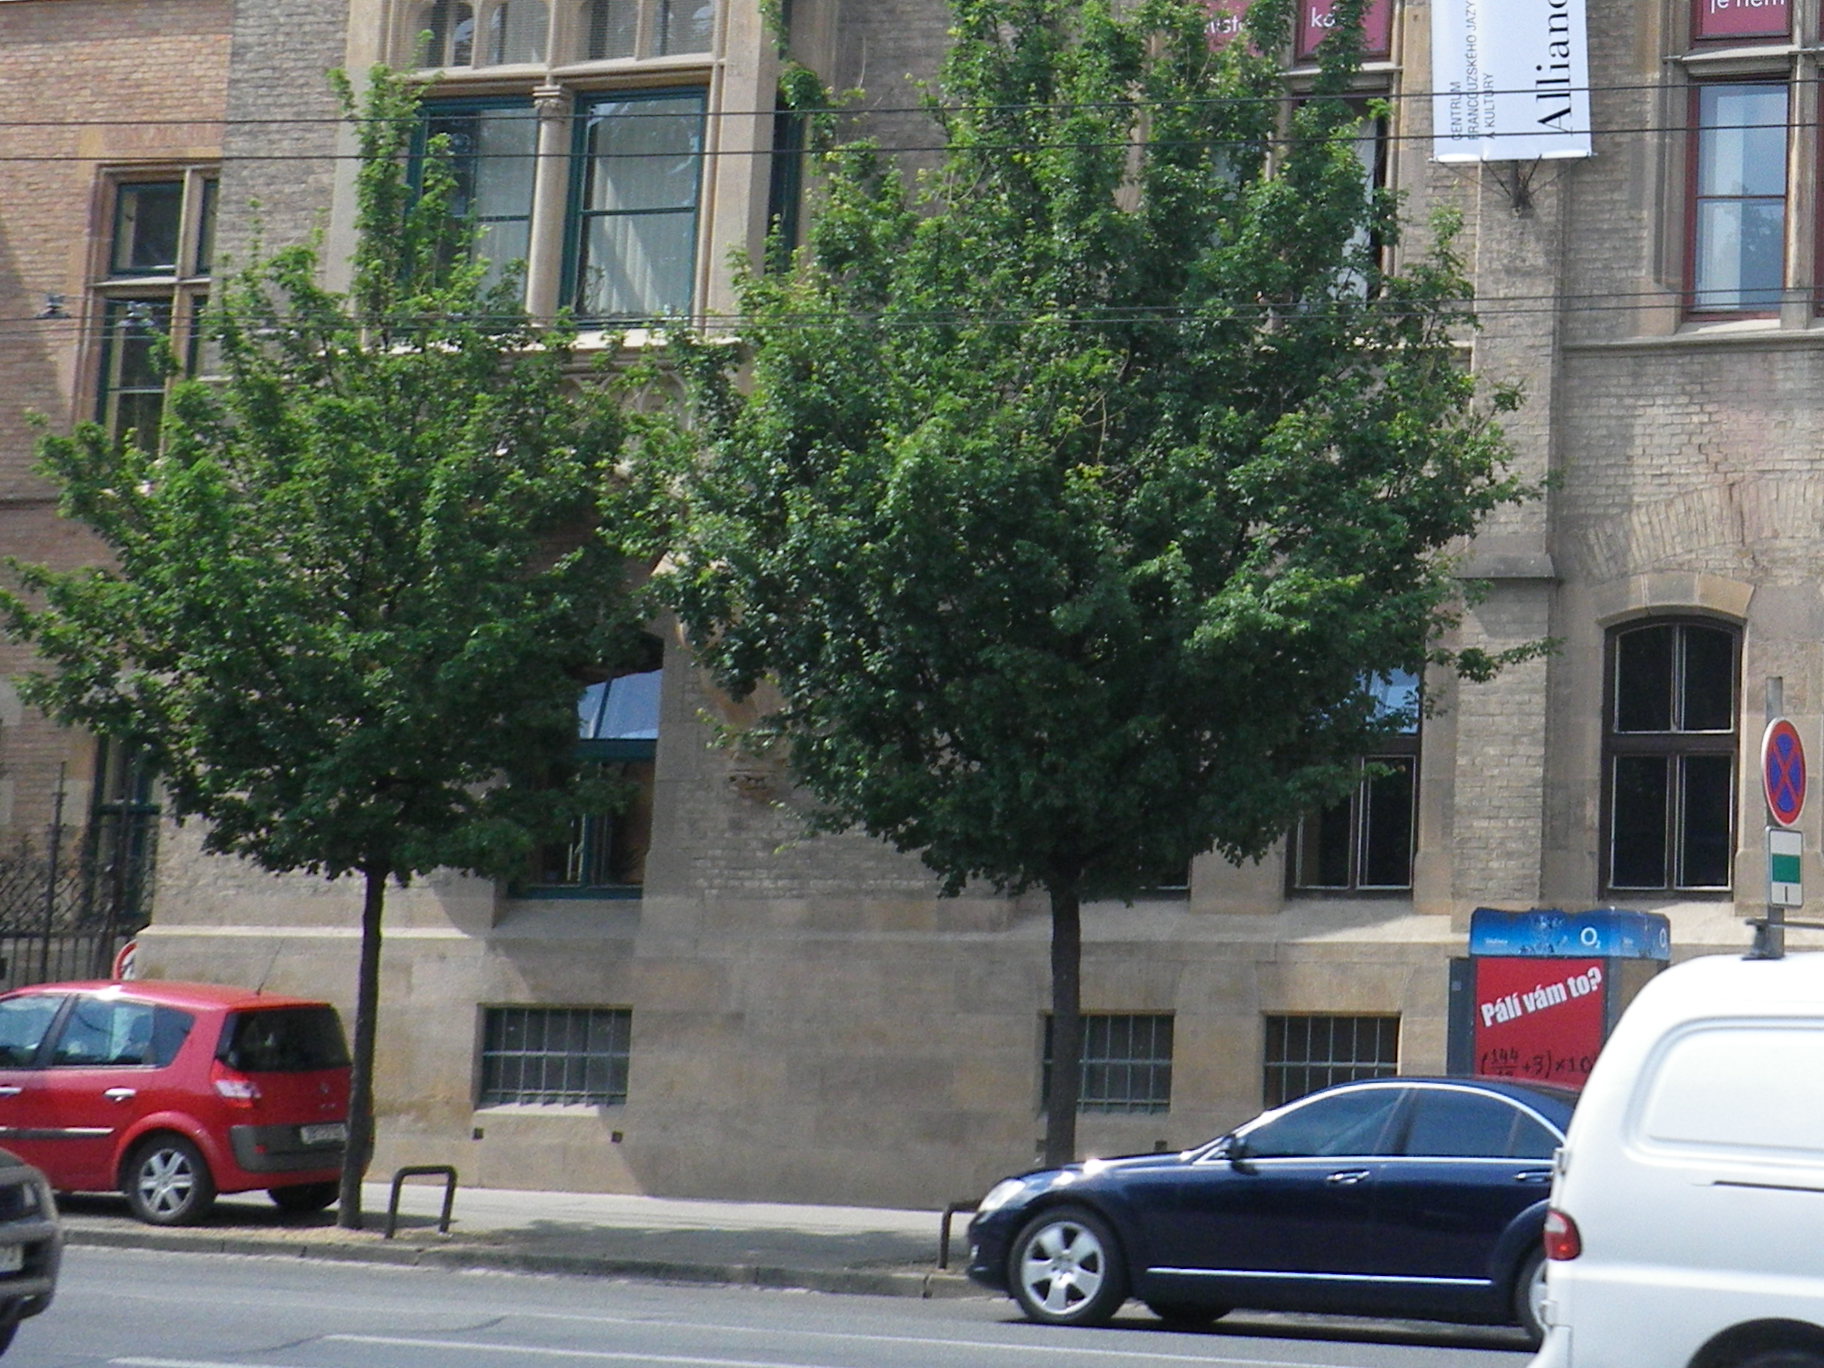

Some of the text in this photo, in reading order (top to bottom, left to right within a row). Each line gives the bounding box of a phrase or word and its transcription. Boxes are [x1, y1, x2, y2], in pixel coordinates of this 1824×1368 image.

[1450, 82, 1463, 141] CENTRUM
[1465, 34, 1480, 141] FRANCOUZSKÉHO
[1482, 73, 1496, 129] KULTURY
[1481, 966, 1603, 1028] Pálí vám to?
